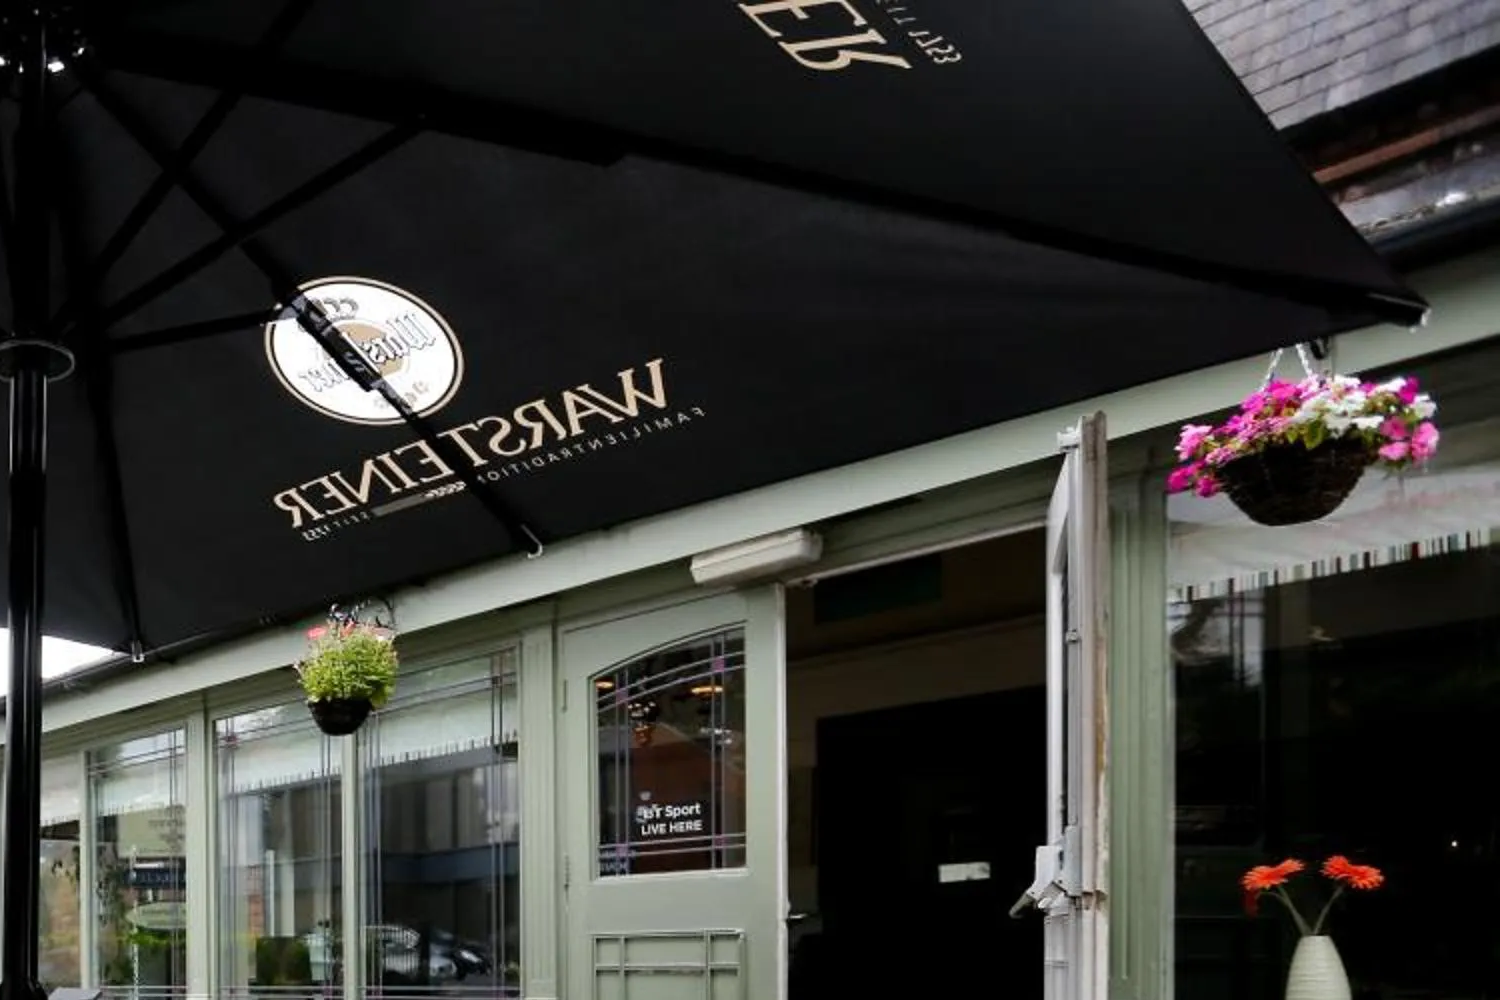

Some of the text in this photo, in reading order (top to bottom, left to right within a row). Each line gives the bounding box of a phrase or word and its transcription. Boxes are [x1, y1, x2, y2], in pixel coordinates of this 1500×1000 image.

[665, 803, 701, 819] Sport
[641, 819, 703, 836] LIVE HERE
